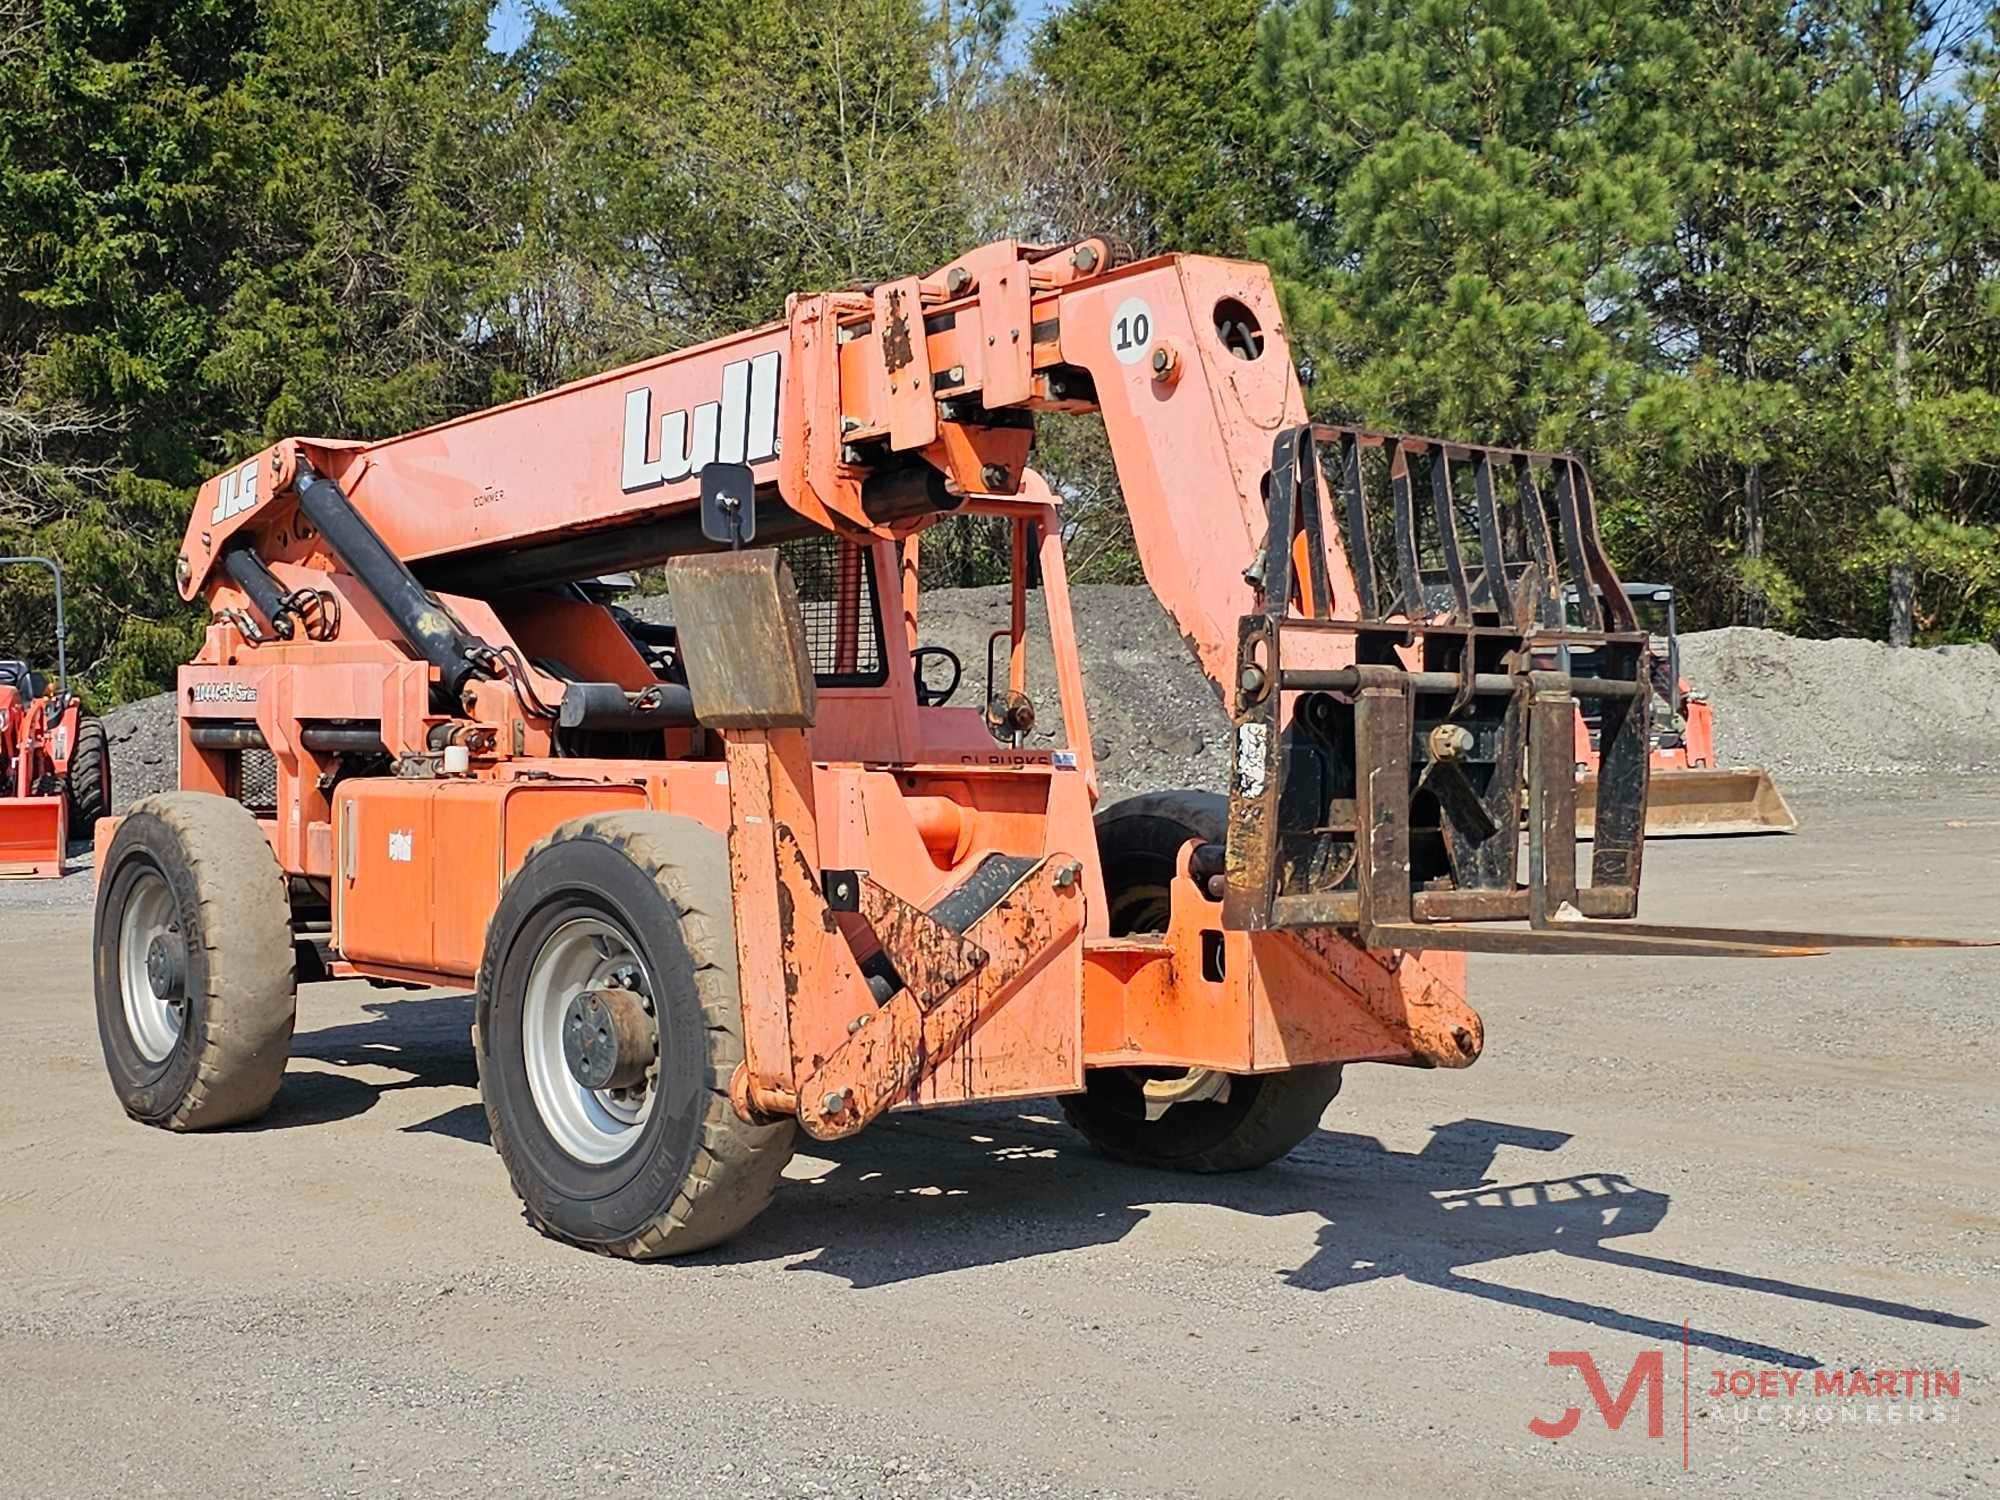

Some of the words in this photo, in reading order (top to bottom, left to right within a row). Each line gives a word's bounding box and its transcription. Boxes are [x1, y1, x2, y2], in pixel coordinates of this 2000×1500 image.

[1116, 313, 1149, 351] 10
[621, 350, 782, 495] Lull
[211, 458, 259, 527] JLG
